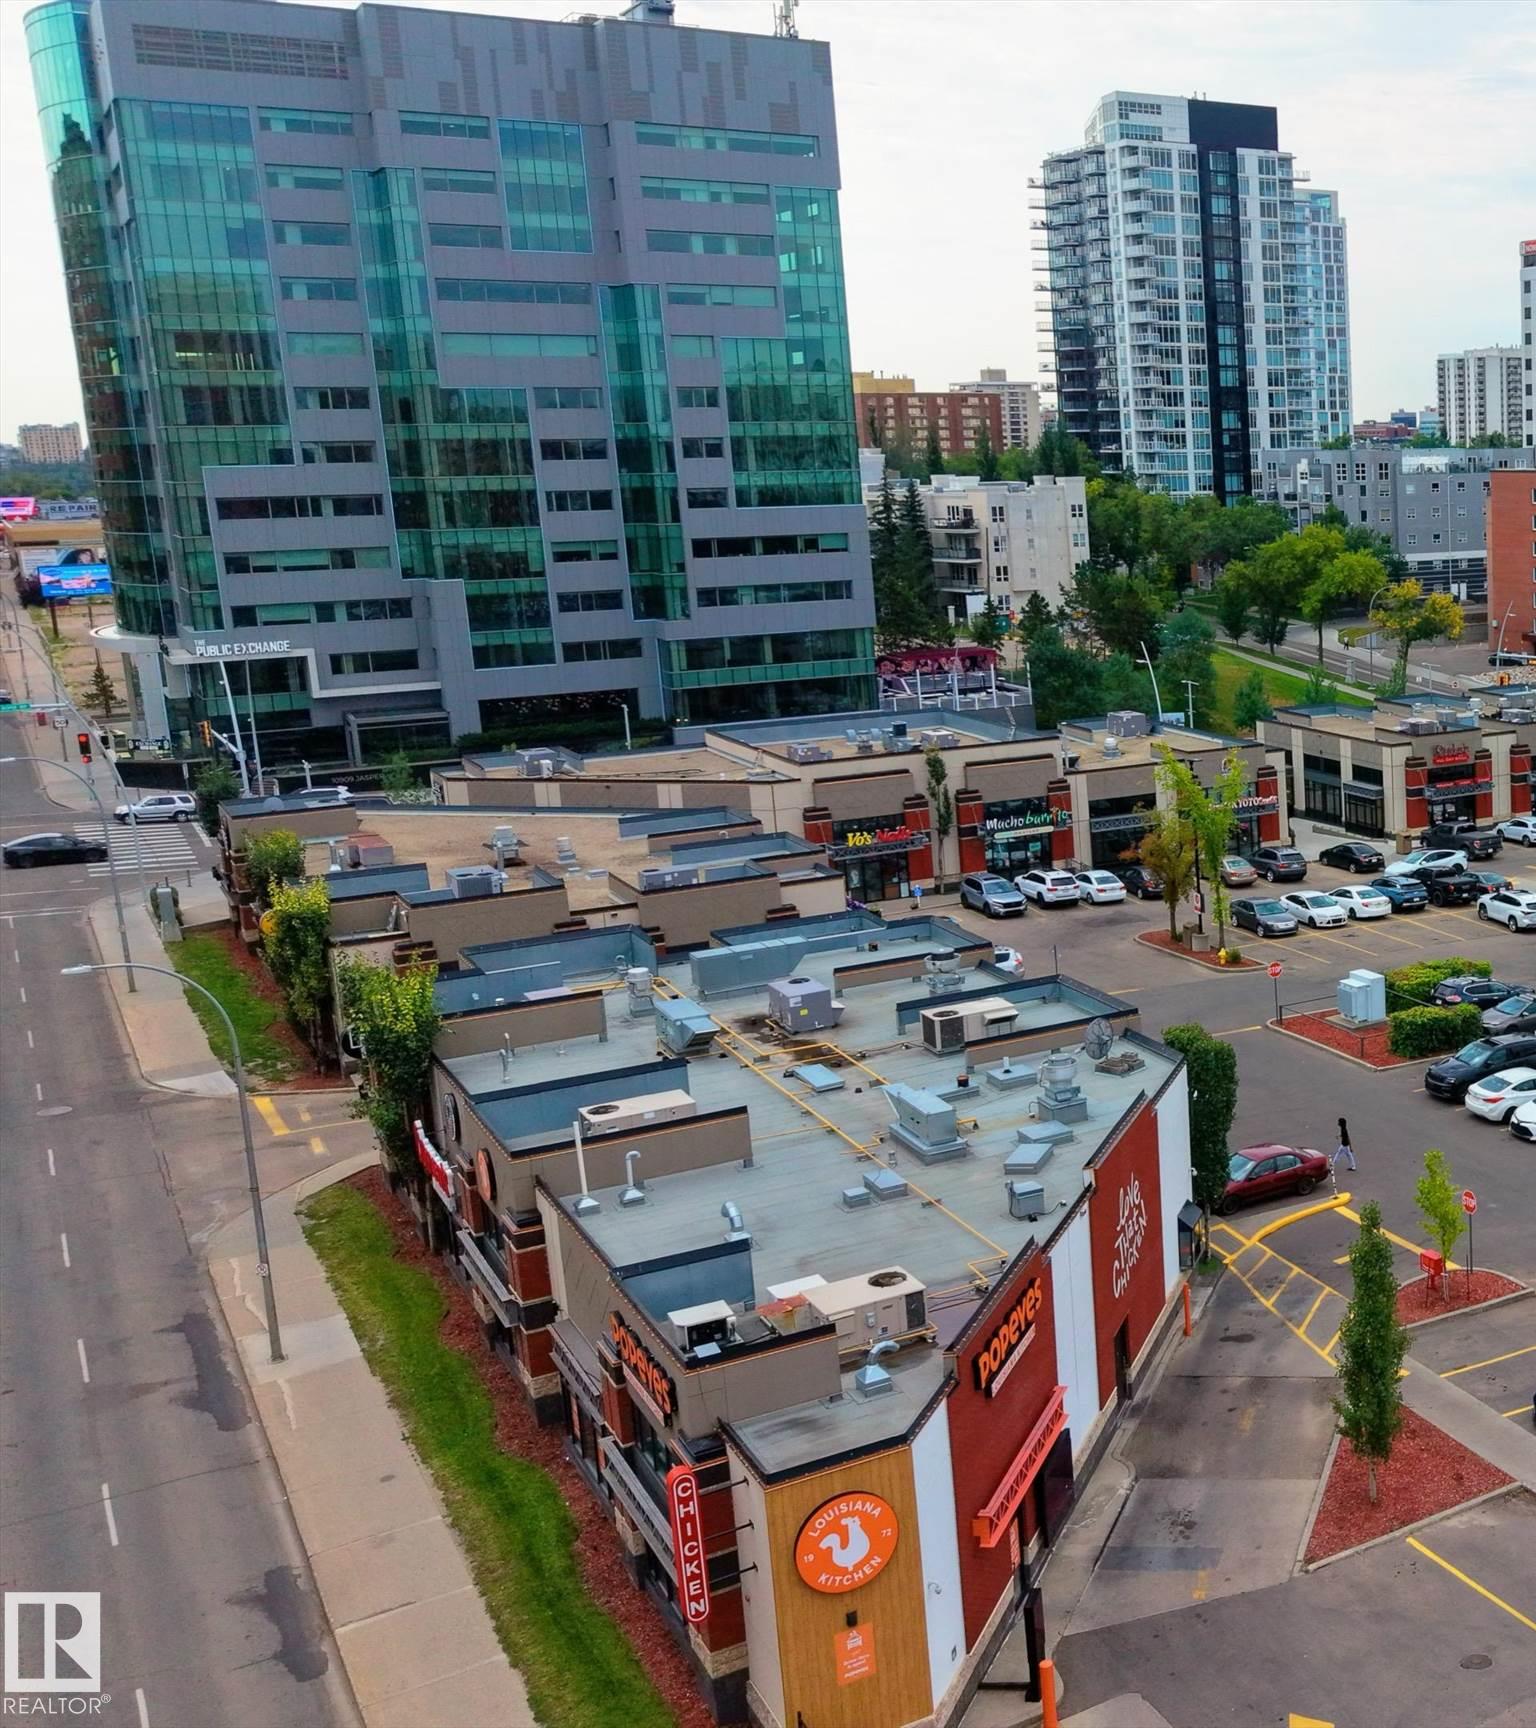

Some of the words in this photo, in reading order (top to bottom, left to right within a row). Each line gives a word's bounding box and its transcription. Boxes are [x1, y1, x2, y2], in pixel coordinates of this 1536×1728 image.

[196, 645, 232, 657] PUBLIC
[234, 640, 290, 656] EXCHANGE
[846, 831, 873, 848] Vo's
[807, 1500, 882, 1538] LOUISIANA
[676, 1481, 706, 1617] CHICKEN
[803, 1553, 815, 1563] 19
[881, 1528, 893, 1537] 72
[817, 1555, 882, 1587] KITCHEN
